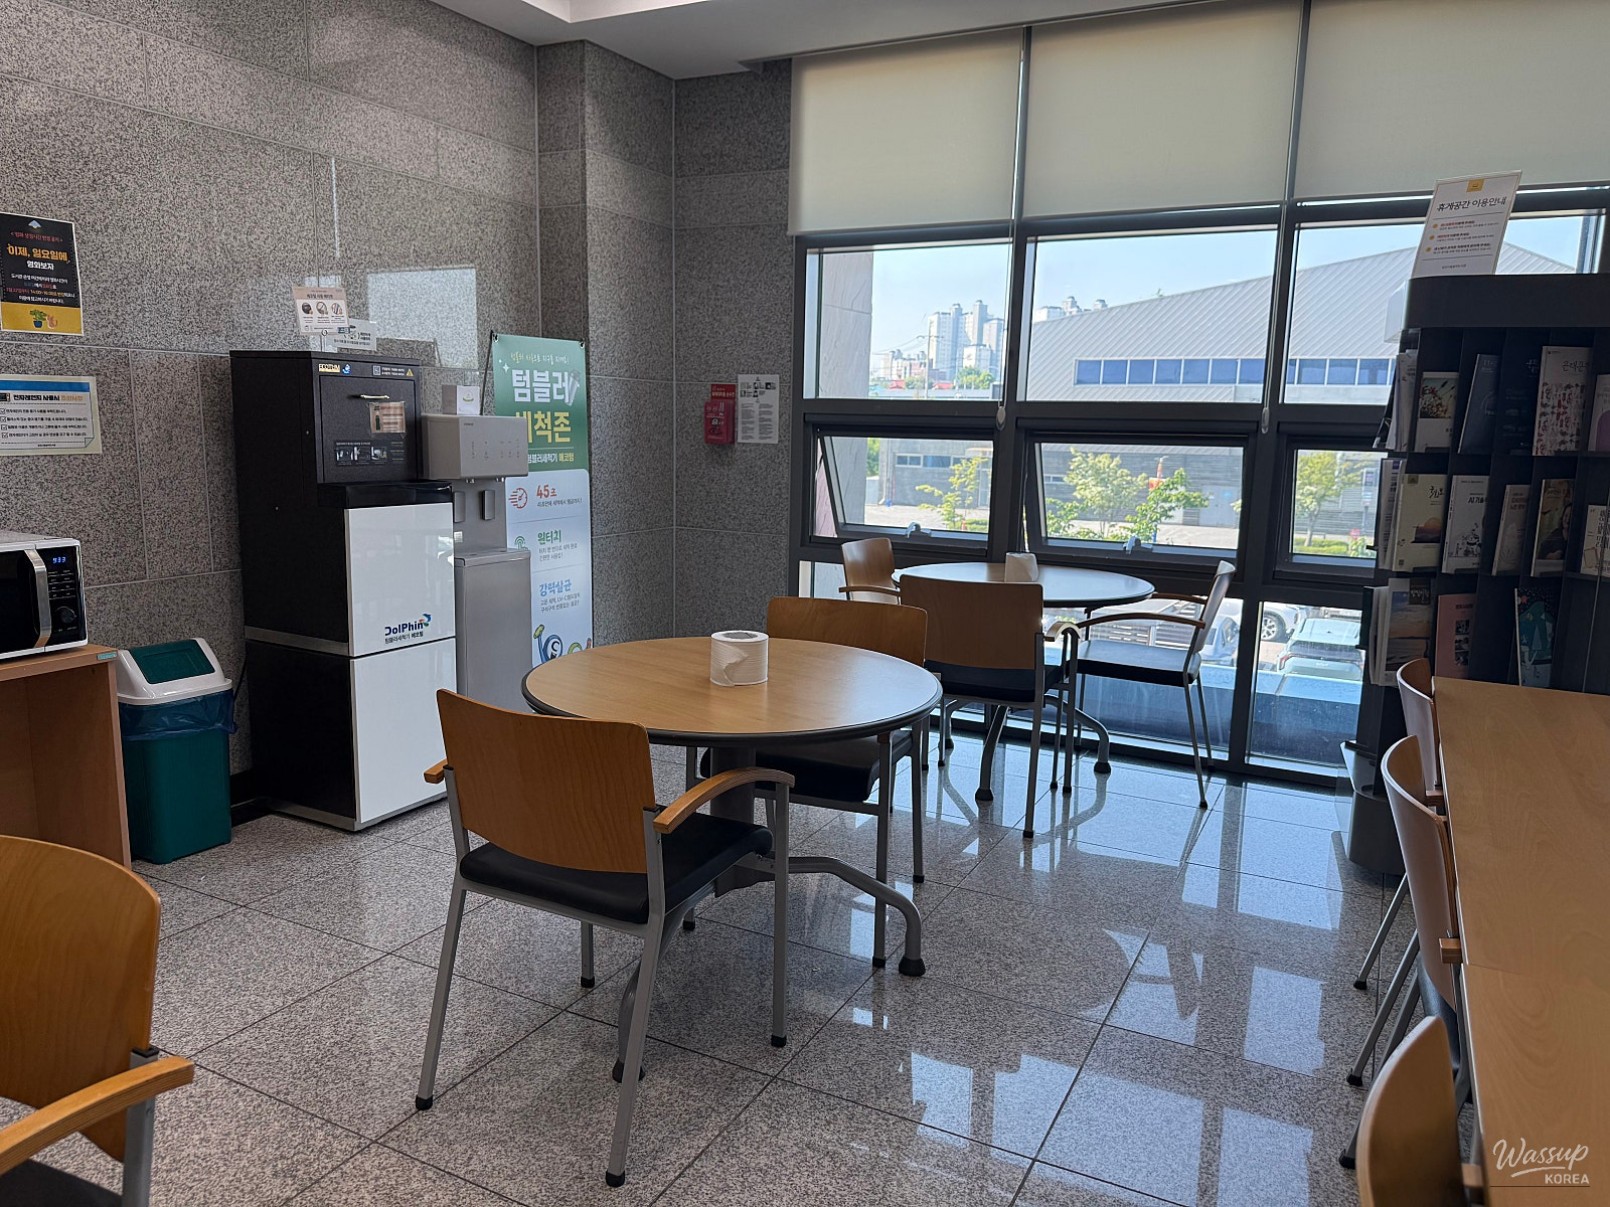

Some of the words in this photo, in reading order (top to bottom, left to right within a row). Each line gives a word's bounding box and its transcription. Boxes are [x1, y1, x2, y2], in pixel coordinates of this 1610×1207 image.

[1437, 201, 1470, 212] 휴게공간
[1472, 197, 1507, 208] 이용안내
[8, 244, 30, 258] 이제,
[32, 248, 69, 262] 일요일에
[26, 260, 55, 271] 영화보자
[511, 369, 570, 403] 텀블러
[536, 484, 558, 499] 45초
[537, 529, 562, 546] 원터치
[539, 578, 572, 598] 강력살균
